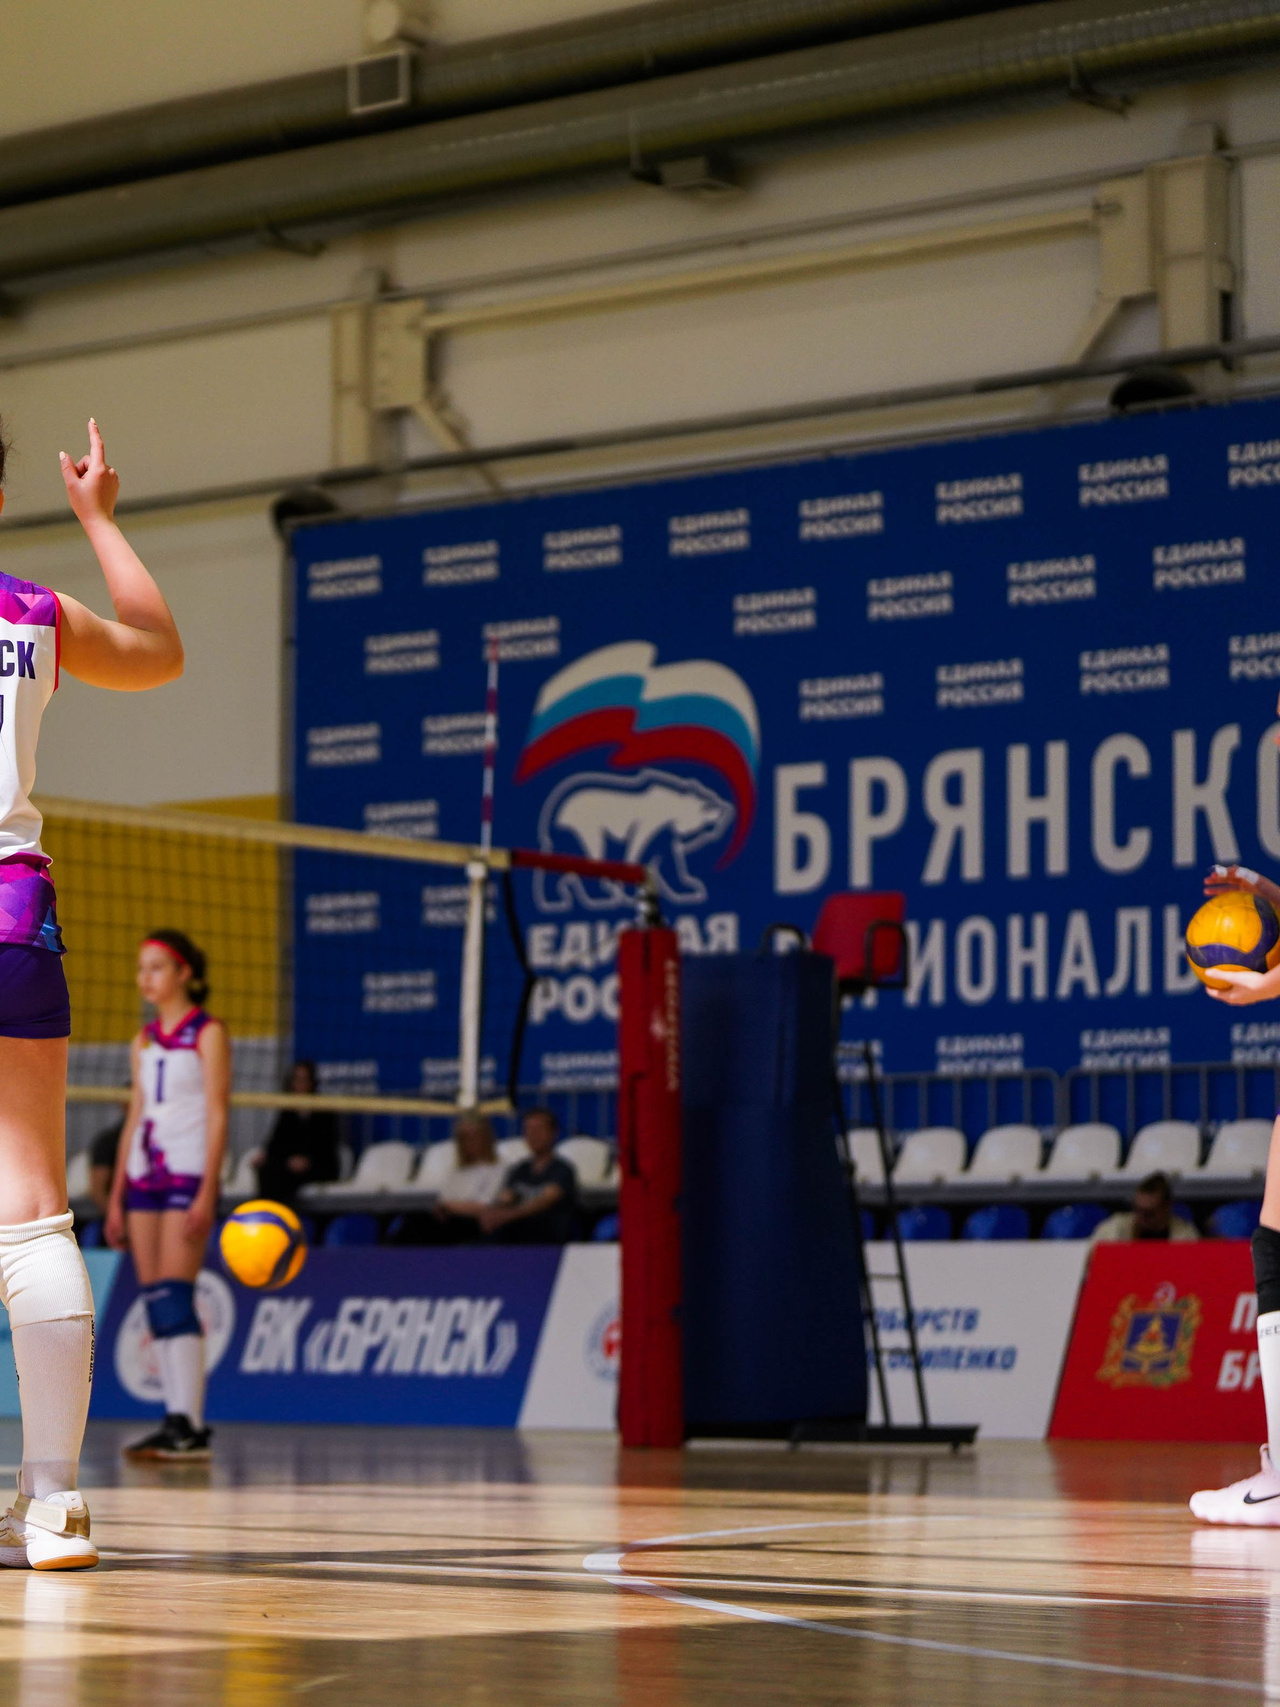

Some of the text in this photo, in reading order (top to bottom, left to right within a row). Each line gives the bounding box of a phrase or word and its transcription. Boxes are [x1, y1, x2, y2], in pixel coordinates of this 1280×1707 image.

[1079, 455, 1168, 482] ЕДИНАЯ
[936, 474, 1022, 500] ЕДИНАЯ
[1079, 478, 1168, 505] РОССИЯ
[800, 492, 882, 518] ЕДИНАЯ
[937, 496, 1022, 523] РОССИЯ
[800, 513, 882, 539] РОССИЯ
[1153, 538, 1244, 565] ЕДИНАЯ
[1008, 556, 1095, 582] ЕДИНАЯ
[1154, 561, 1244, 588] РОССИЯ
[868, 572, 952, 598] ЕДИНАЯ
[1008, 577, 1095, 604] РОССИЯ
[868, 594, 952, 620] РОССИЯ
[1080, 645, 1169, 670] ЕДИНАЯ
[937, 659, 1023, 686] ЕДИНАЯ
[1080, 667, 1169, 693] РОССИЯ
[937, 682, 1023, 707] РОССИЯ
[527, 913, 739, 970] ЕДИАЯ
[239, 1299, 313, 1373] ВК
[303, 1297, 518, 1377] «БРЯНСК»
